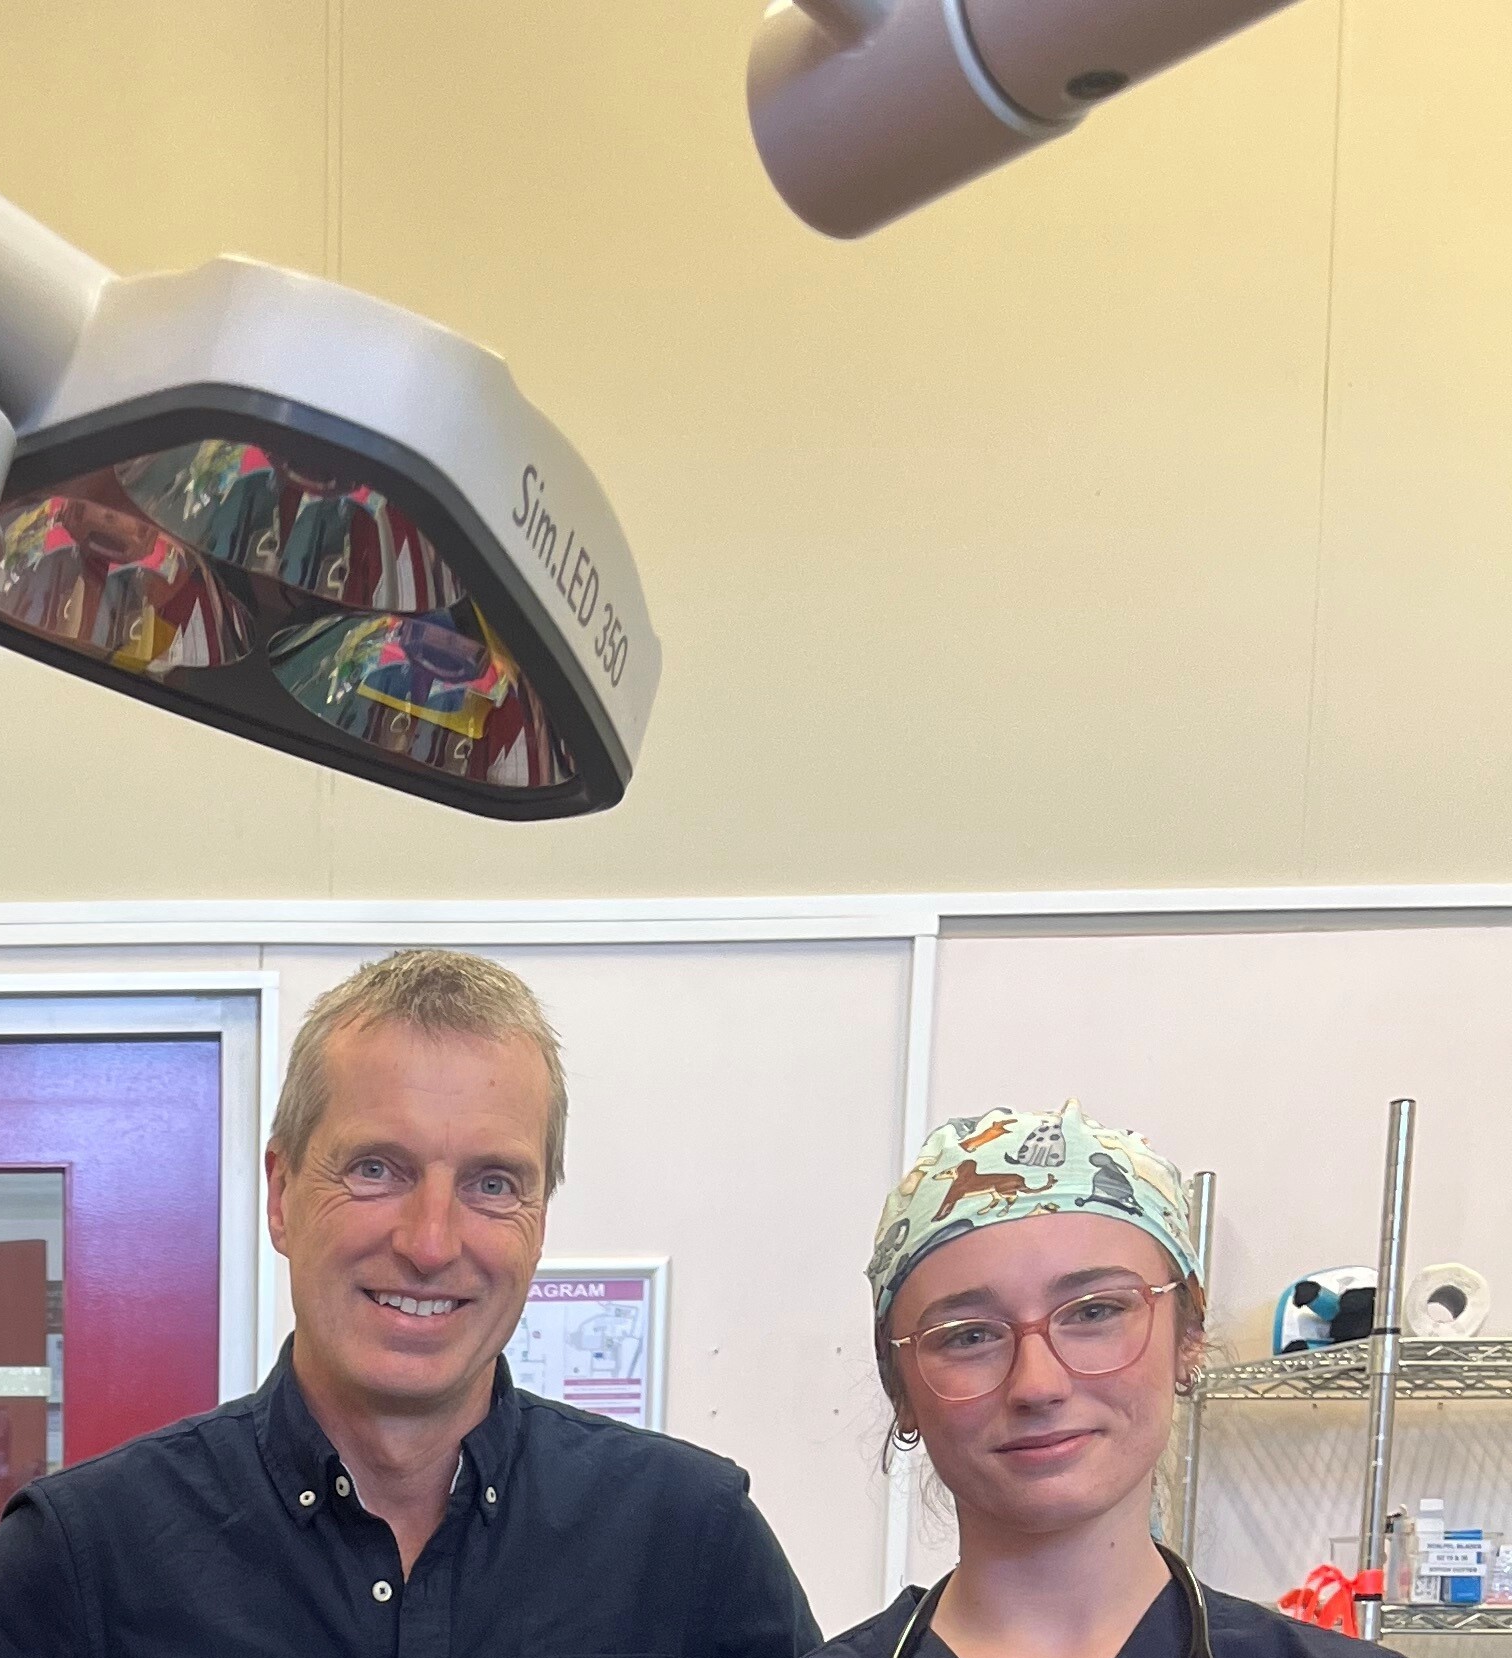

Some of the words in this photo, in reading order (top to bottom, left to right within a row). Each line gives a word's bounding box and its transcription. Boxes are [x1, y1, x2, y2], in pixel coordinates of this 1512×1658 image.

[511, 463, 600, 628] Sim.LED
[594, 602, 629, 689] 350
[528, 1283, 606, 1298] AGRAM
